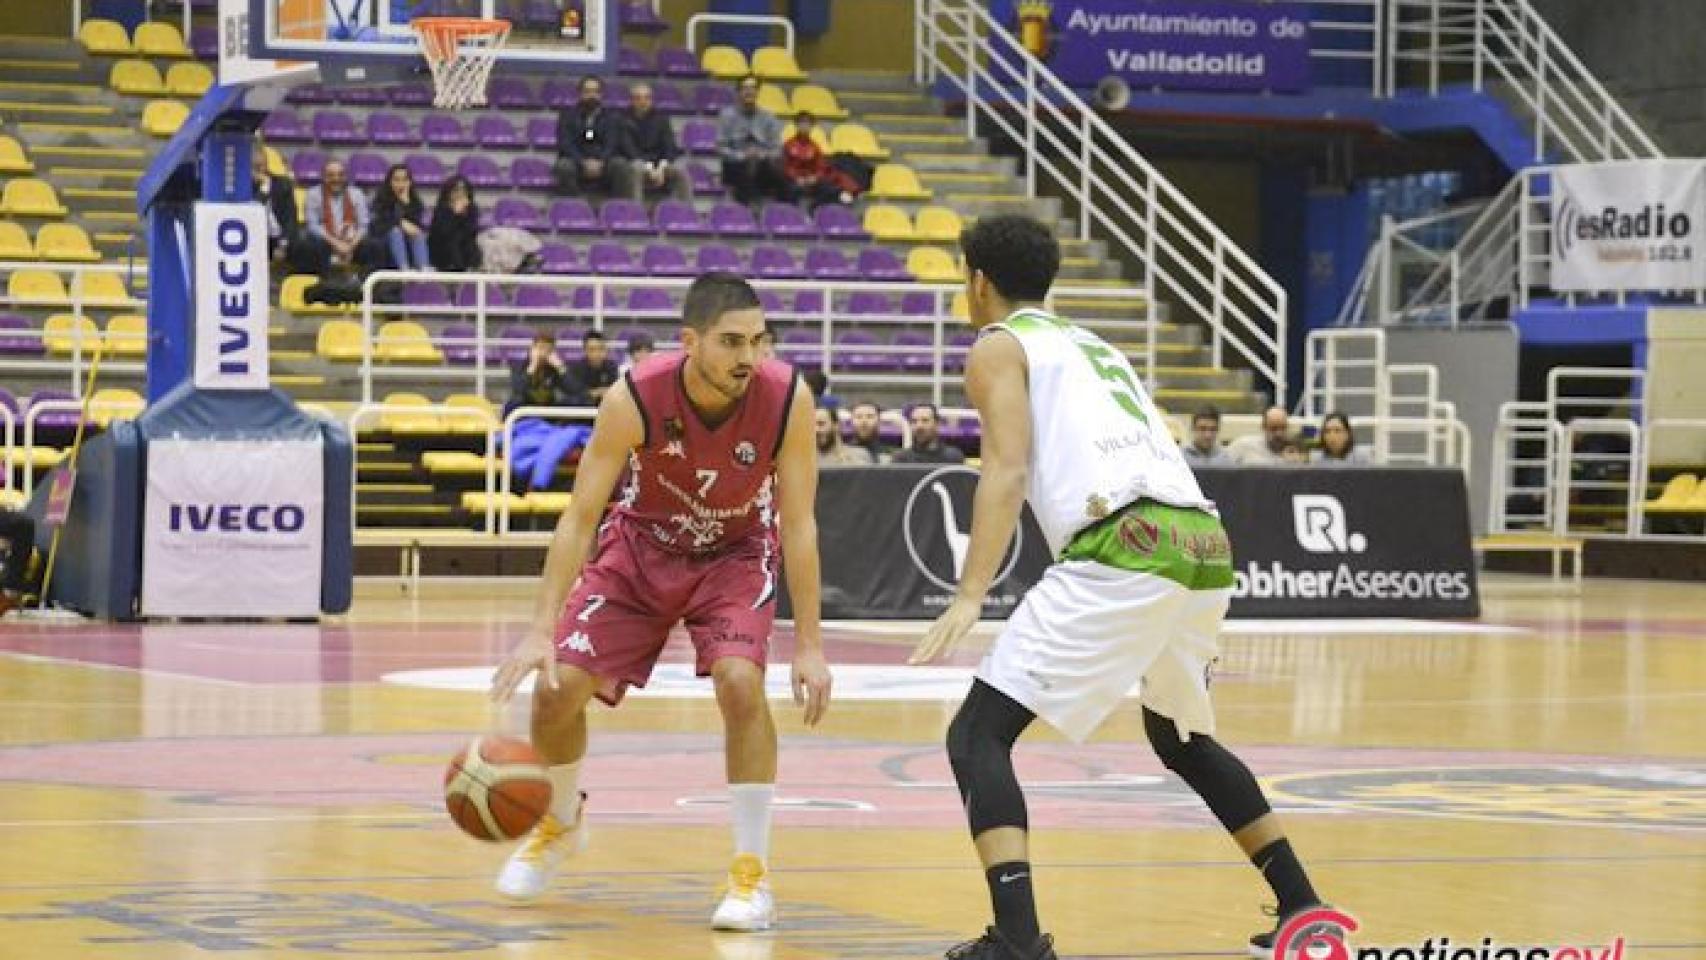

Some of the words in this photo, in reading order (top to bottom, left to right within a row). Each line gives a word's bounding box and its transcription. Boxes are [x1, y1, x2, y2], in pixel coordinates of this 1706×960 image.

[1067, 8, 1257, 36] Ayuntamiento
[1269, 15, 1305, 38] de
[1107, 48, 1265, 76] Valladolid
[1575, 202, 1692, 240] esRadio
[217, 218, 249, 376] IVECO
[695, 469, 720, 498] 7
[169, 503, 305, 532] IVECO
[1231, 560, 1471, 599] obherAsesores
[576, 594, 608, 622] 7
